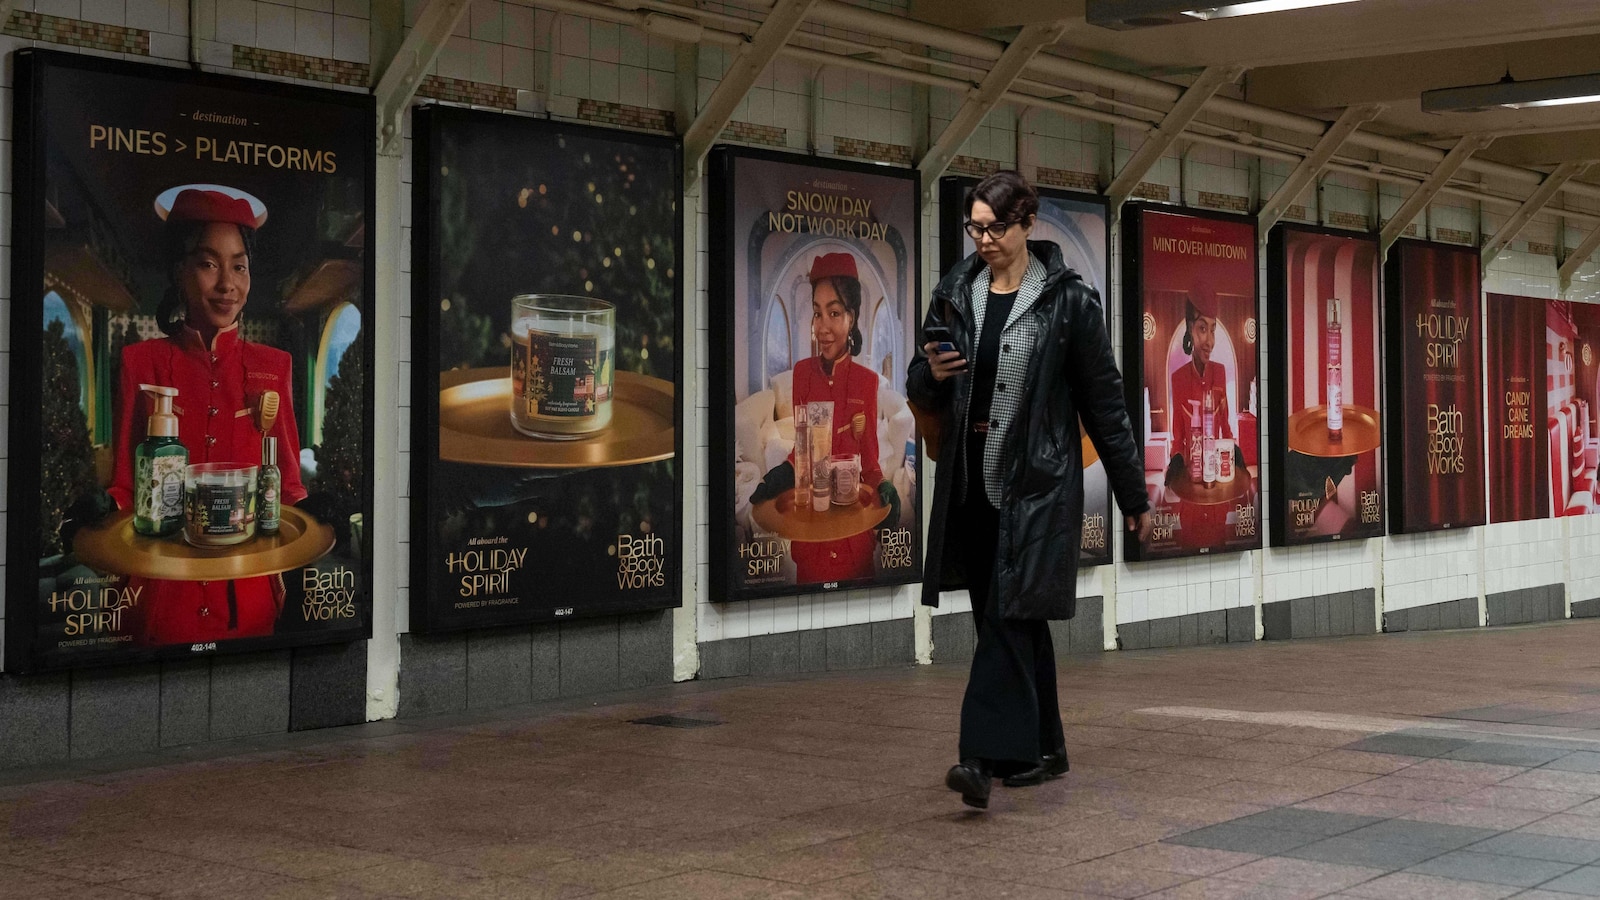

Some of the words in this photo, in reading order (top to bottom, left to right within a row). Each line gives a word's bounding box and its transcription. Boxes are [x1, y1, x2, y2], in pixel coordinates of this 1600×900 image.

[192, 109, 248, 126] destination
[89, 124, 167, 156] PINES
[195, 136, 338, 174] PLATFORMS
[812, 179, 848, 191] destination
[787, 190, 838, 214] SNOW
[842, 196, 872, 218] DAY
[768, 211, 805, 233] NOT
[806, 215, 856, 239] WORK
[859, 221, 889, 242] DAY
[1152, 236, 1177, 253] MINT
[1178, 239, 1203, 256] OVER
[1204, 242, 1247, 260] MIDTOWN
[1415, 313, 1469, 340] HOLIDAY
[553, 357, 574, 366] FRESH
[1426, 338, 1462, 368] SPIRIT
[550, 366, 576, 376] BALSAM
[1505, 391, 1530, 406] CANDY
[1427, 403, 1463, 434] Bath
[1508, 408, 1529, 422] CANE
[1503, 424, 1534, 439] DREAMS
[1427, 452, 1465, 475] Works
[1360, 490, 1379, 505] Bath
[1235, 503, 1254, 518] Bath
[477, 536, 498, 545] aboard
[498, 535, 509, 544] the
[880, 527, 912, 546] Bath
[1152, 523, 1175, 541] SPIRIT
[1235, 526, 1256, 537] Works
[617, 532, 664, 559] Bath
[738, 540, 791, 559] HOLIDAY
[445, 547, 529, 574] HOLIDAY
[747, 555, 784, 576] SPIRIT
[880, 553, 912, 569] Works
[302, 566, 355, 593] Bath
[459, 566, 516, 597] SPIRIT
[616, 570, 665, 591] Works
[48, 585, 143, 613] HOLIDAY
[64, 605, 129, 636] SPIRIT
[302, 601, 356, 621] Works
[57, 639, 88, 648] POWERED
[190, 642, 217, 652] 402-149
